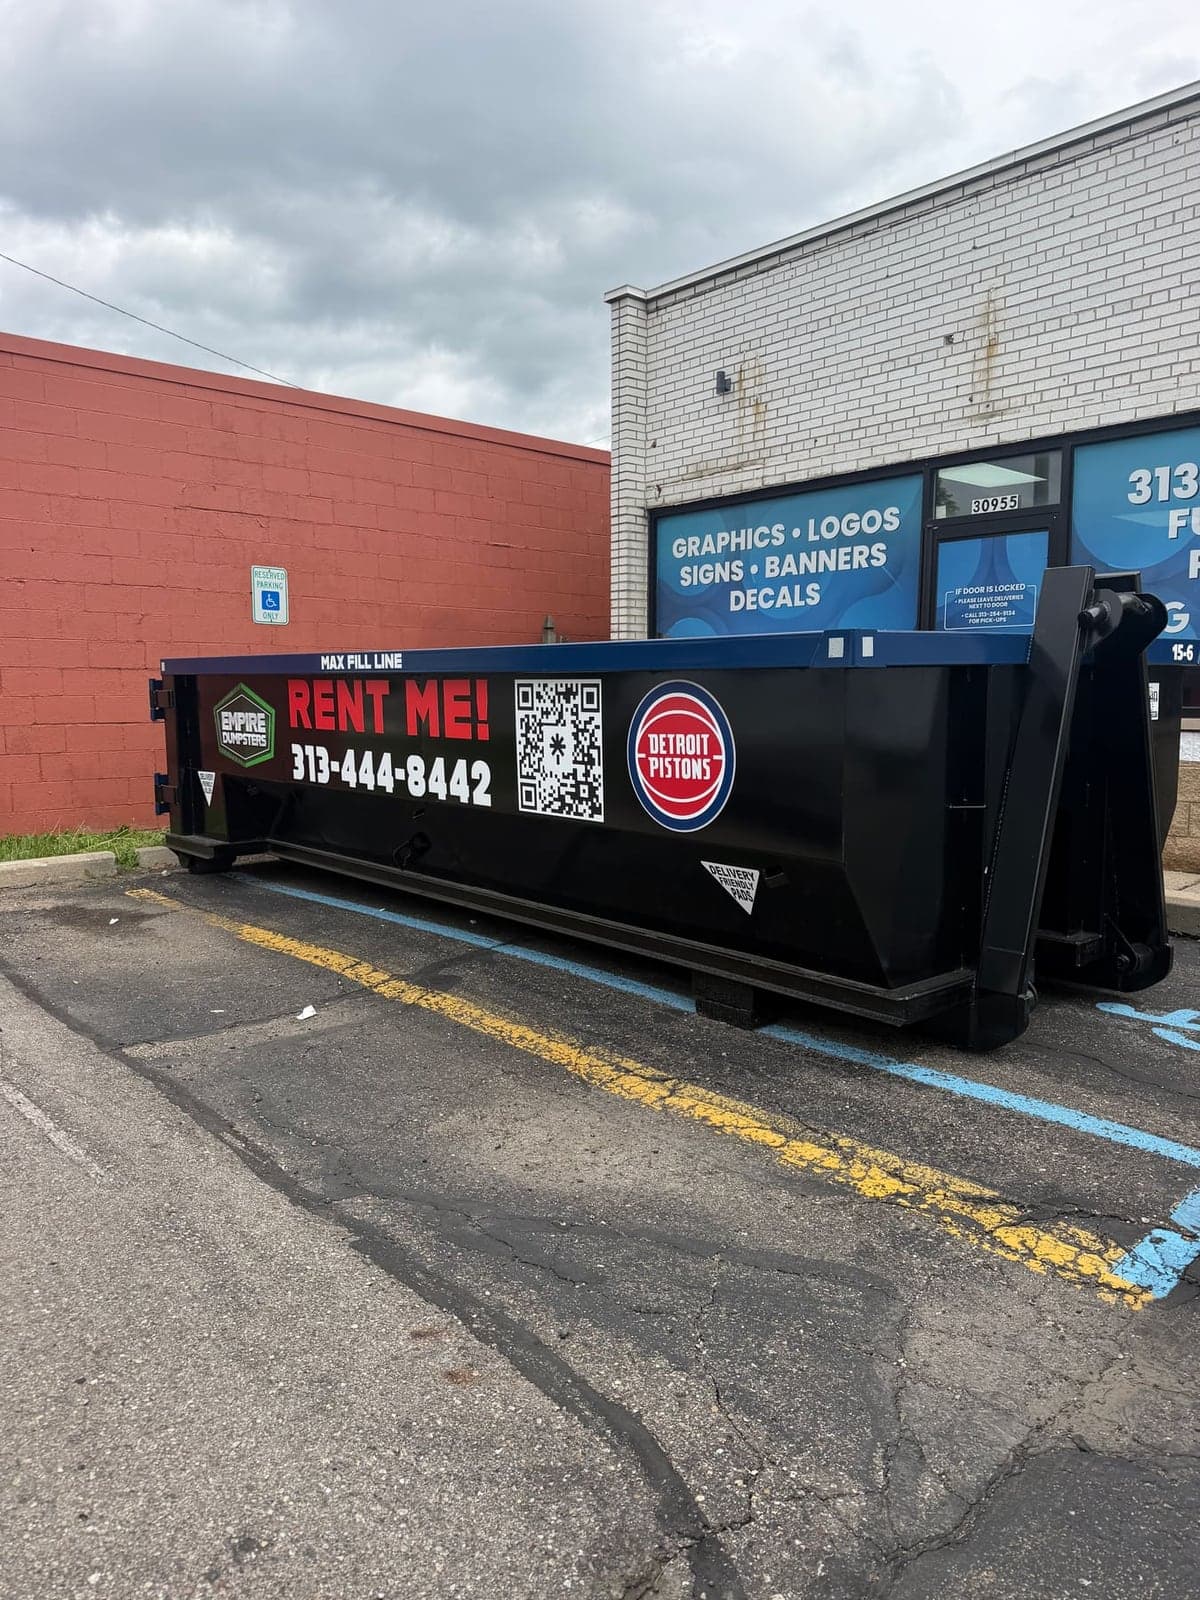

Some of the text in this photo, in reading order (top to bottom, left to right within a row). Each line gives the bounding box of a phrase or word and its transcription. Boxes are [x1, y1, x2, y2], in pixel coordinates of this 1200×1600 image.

[973, 495, 1018, 513] 30955
[672, 507, 901, 559] GRAPHICS LOGOS
[680, 543, 887, 587] SIGNS BANNERS
[254, 570, 285, 580] RESERVED
[257, 581, 283, 590] PARKING
[955, 583, 1026, 595] IF DOOR IS LOCKED
[729, 583, 821, 612] DECALS
[993, 594, 1024, 602] DELIVERIES
[262, 612, 278, 620] ONLY
[321, 653, 402, 670] MAX FILL LINE
[287, 679, 490, 741] RENT ME!
[221, 711, 266, 733] EMPIRE
[222, 731, 267, 747] DUMPSTERS
[648, 733, 710, 756] DETROIT
[291, 743, 492, 808] 313-444-8442
[648, 756, 711, 780] PISTONS
[709, 865, 755, 882] DELIVERY
[719, 877, 754, 891] FRIENDLY
[731, 888, 754, 902] PADS
